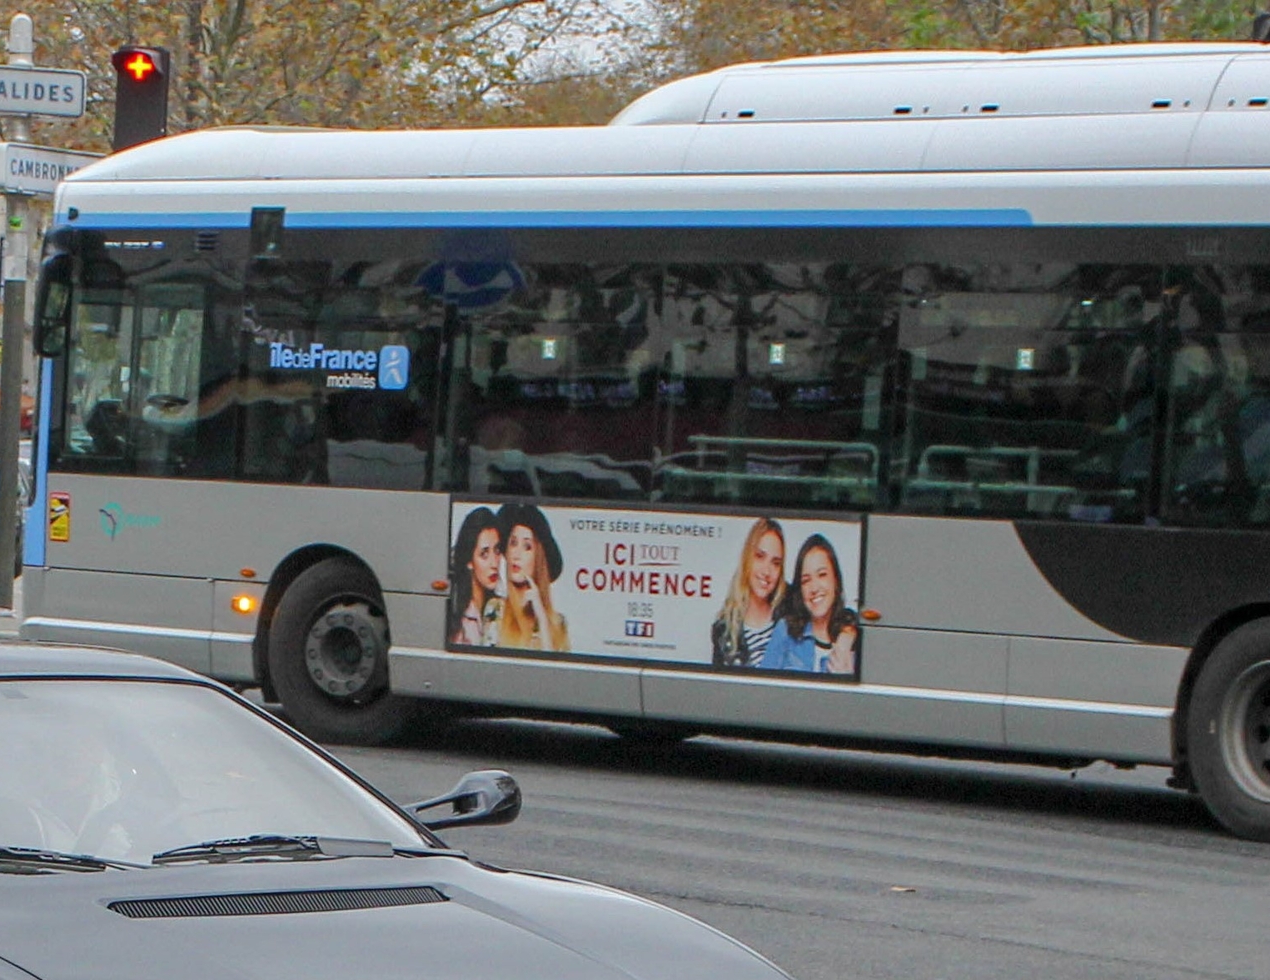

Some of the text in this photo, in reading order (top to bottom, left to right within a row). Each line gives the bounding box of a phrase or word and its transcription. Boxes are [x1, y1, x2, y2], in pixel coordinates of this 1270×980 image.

[326, 373, 376, 388] mobilités
[570, 520, 605, 531] VOTRE
[609, 518, 640, 533] SÉRIE
[605, 543, 680, 565] ICI TOUT
[576, 569, 712, 597] COMMENCE
[626, 621, 654, 637] TF1
